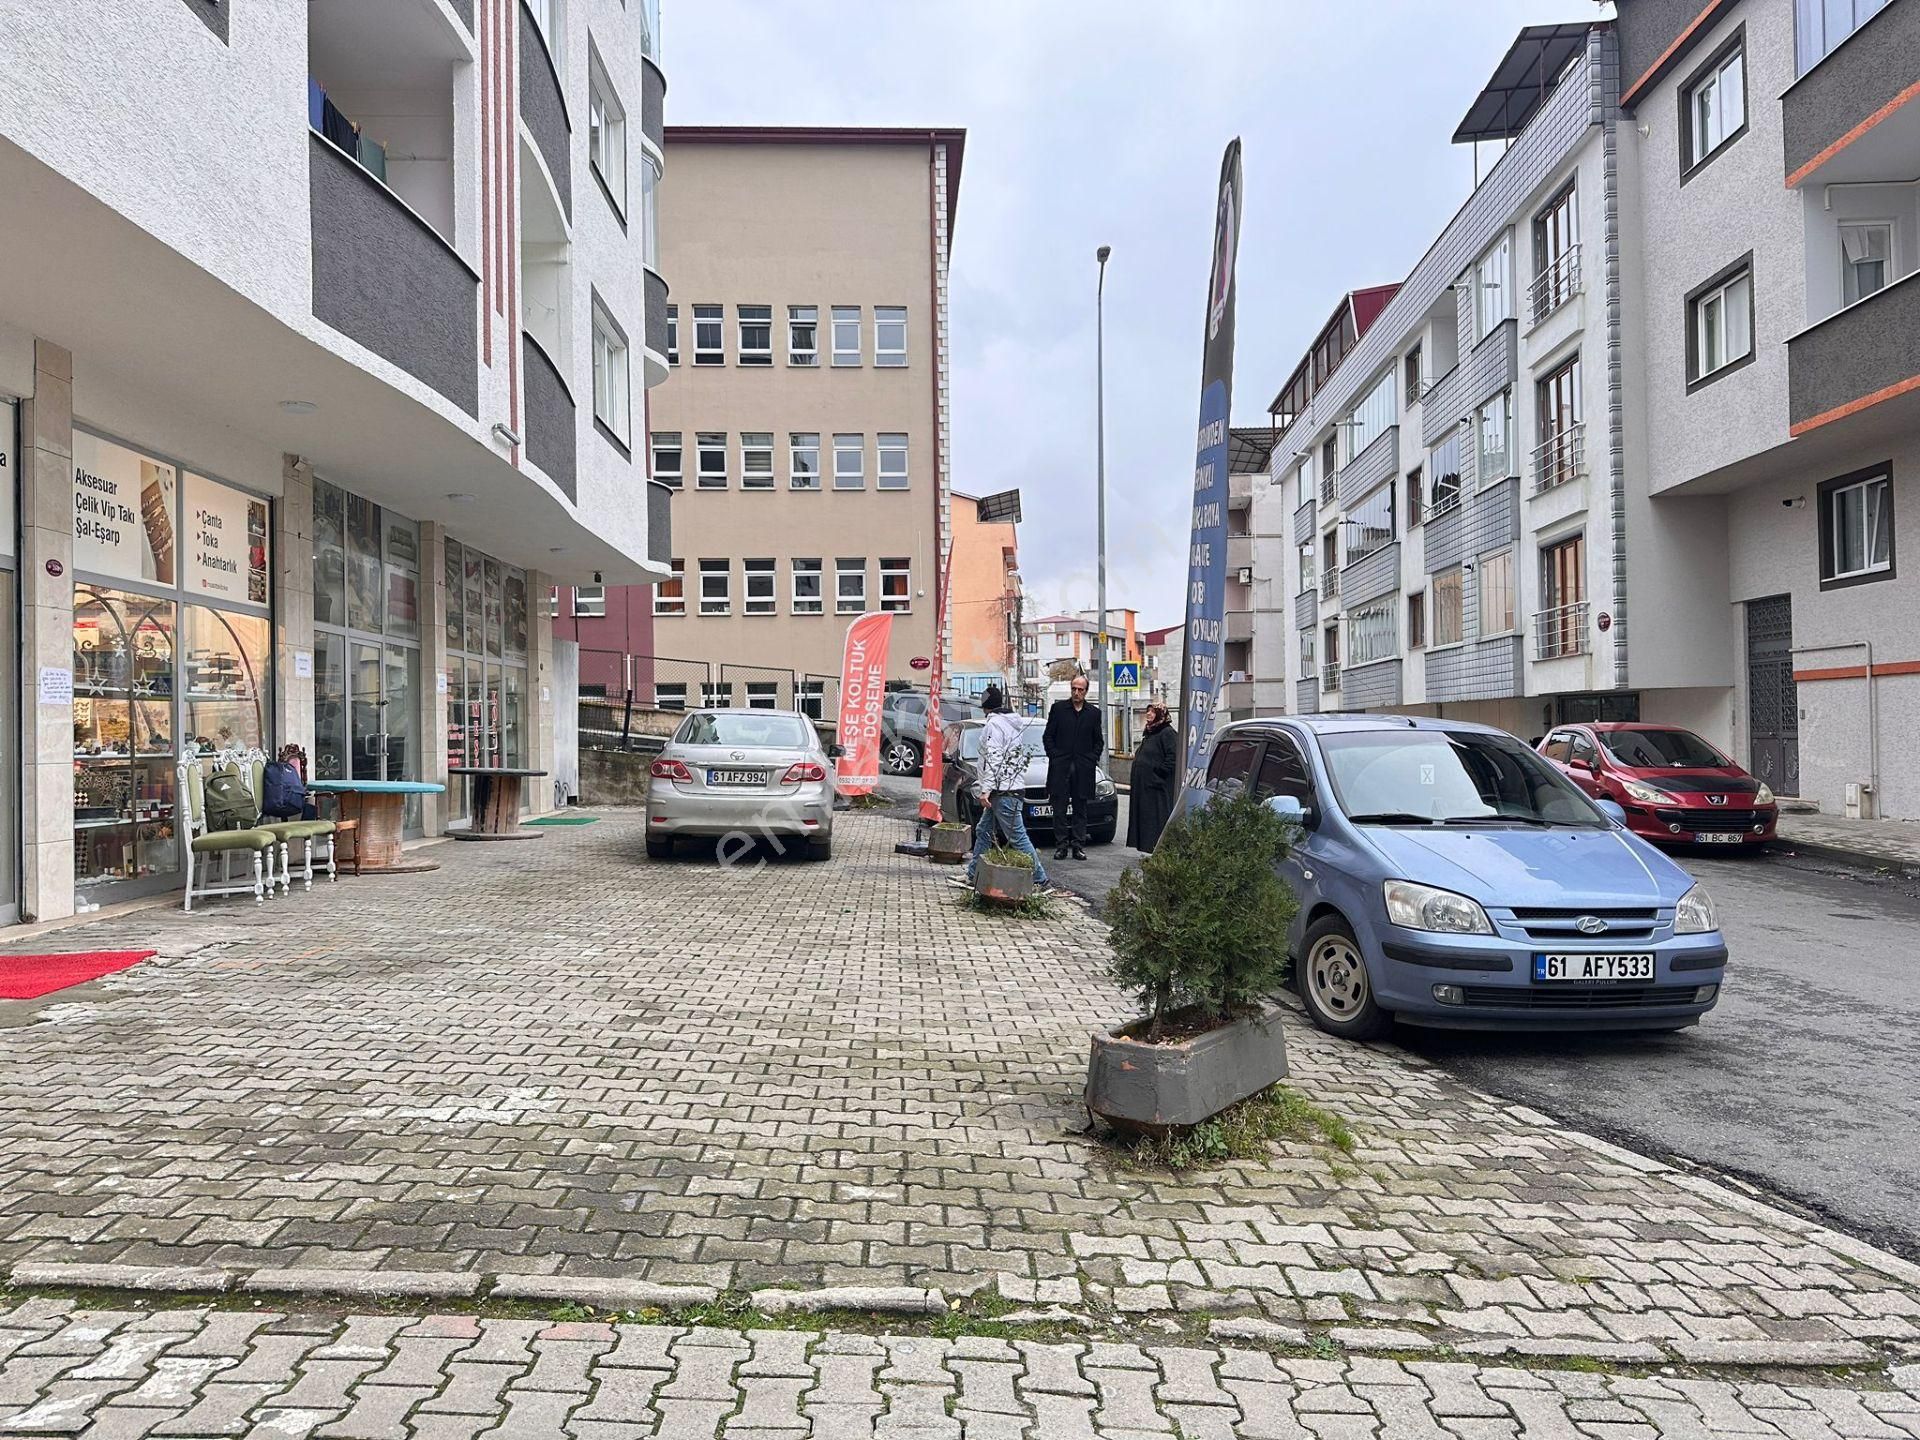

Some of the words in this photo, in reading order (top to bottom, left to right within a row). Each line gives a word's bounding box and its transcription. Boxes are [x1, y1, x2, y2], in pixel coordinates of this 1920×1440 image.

[75, 467, 118, 495] Aksesuar
[75, 492, 99, 514] Çelik
[101, 499, 116, 522] Vip
[117, 504, 135, 525] Takı
[201, 510, 223, 529] Çanta
[75, 517, 120, 546] Şal-Eşarp
[201, 531, 219, 549] Toka
[201, 552, 238, 574] Anahtarlık
[847, 639, 867, 709] KOLTUK
[860, 664, 883, 738] DÖŞEME
[844, 713, 862, 762] MEŞE
[713, 771, 723, 783] 61
[727, 771, 748, 783] AFZ
[749, 771, 765, 784] 994
[1548, 956, 1567, 977] 61
[1582, 956, 1651, 977] AFY533
